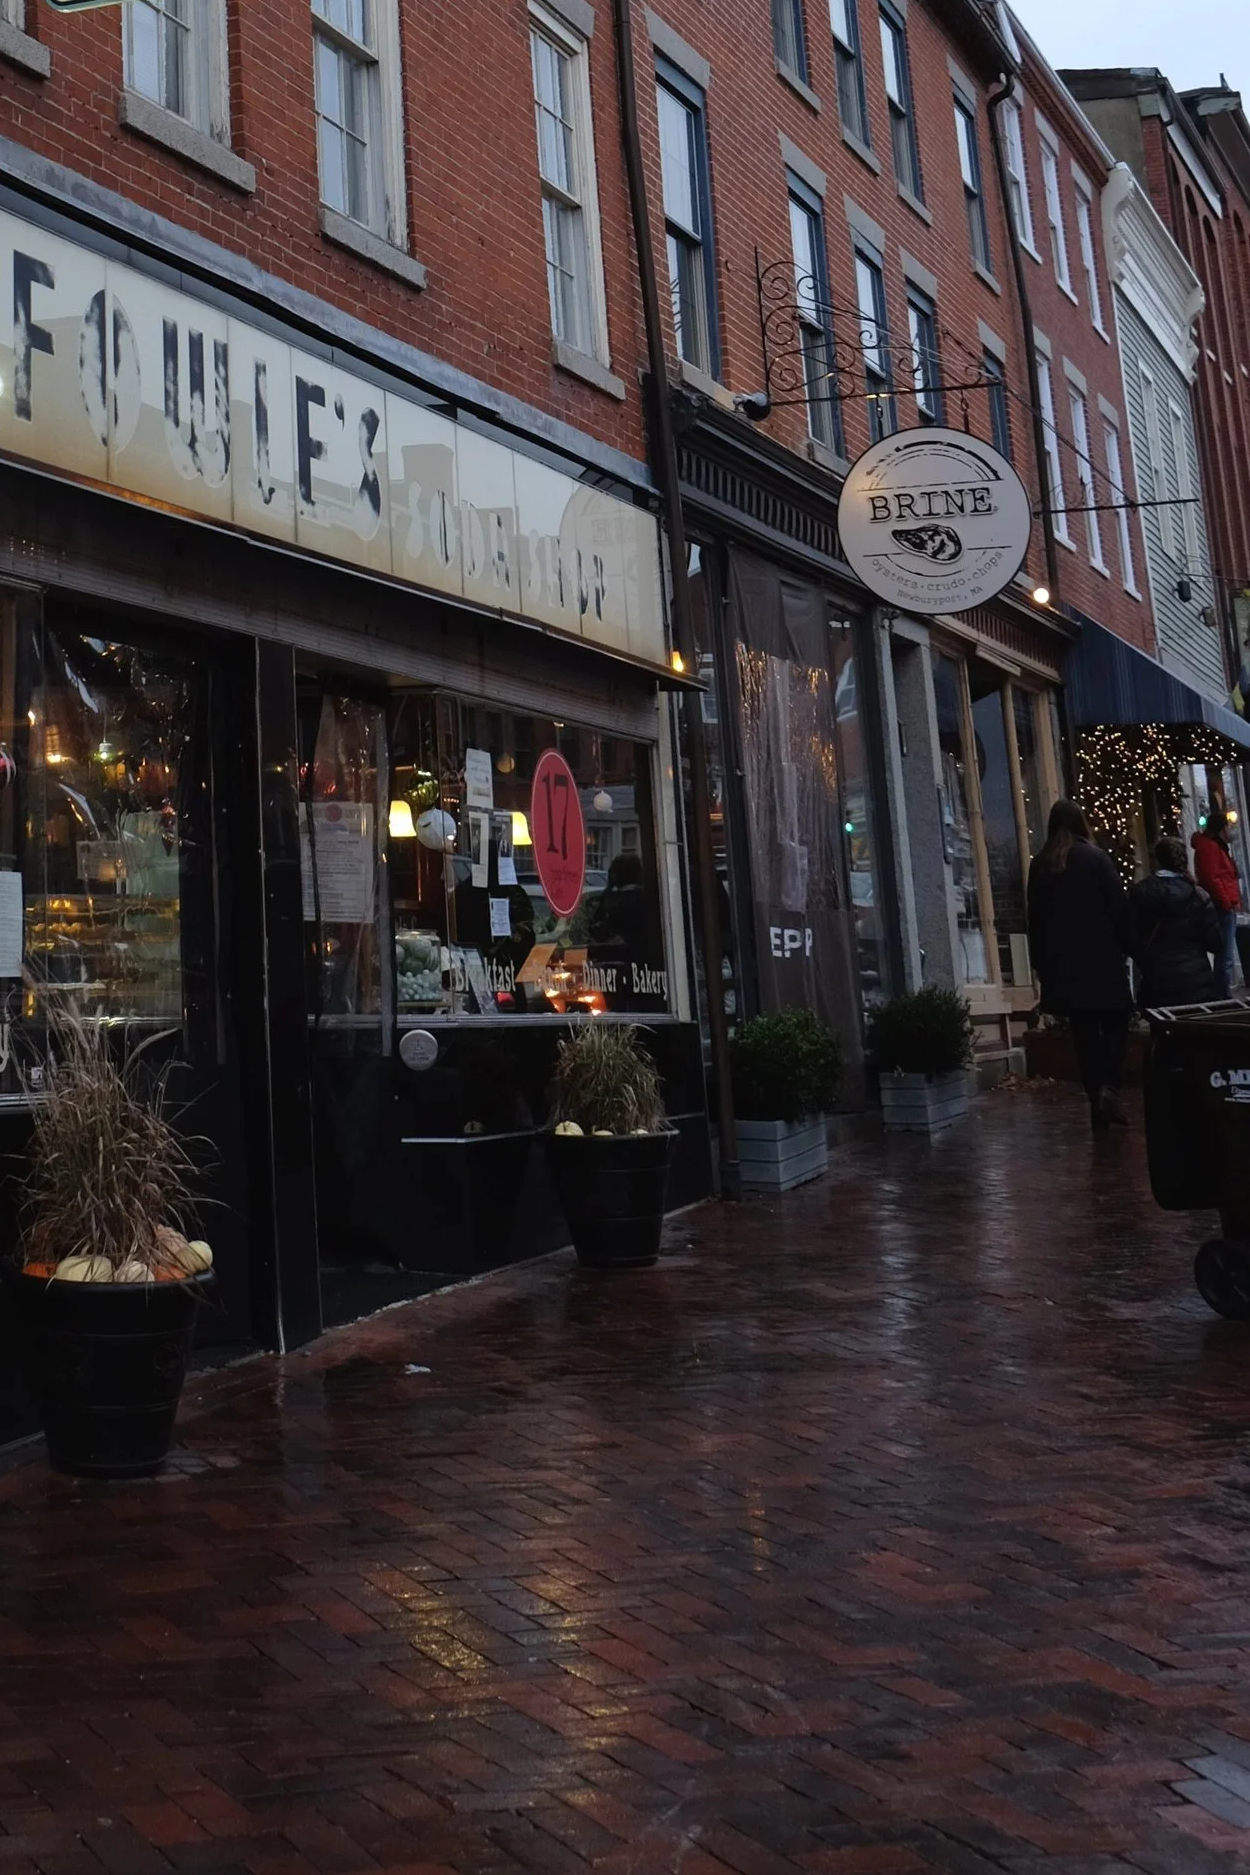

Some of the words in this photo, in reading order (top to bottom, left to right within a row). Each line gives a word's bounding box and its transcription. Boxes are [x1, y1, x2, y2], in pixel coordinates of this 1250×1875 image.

[12, 249, 382, 541] FOWLE'S
[868, 486, 993, 523] BRINE
[871, 558, 919, 589] oysters
[926, 577, 966, 592] crudo
[972, 551, 1004, 581] chops
[542, 771, 570, 861] 17
[582, 960, 618, 993] Dinner
[631, 961, 668, 1001] Bakery
